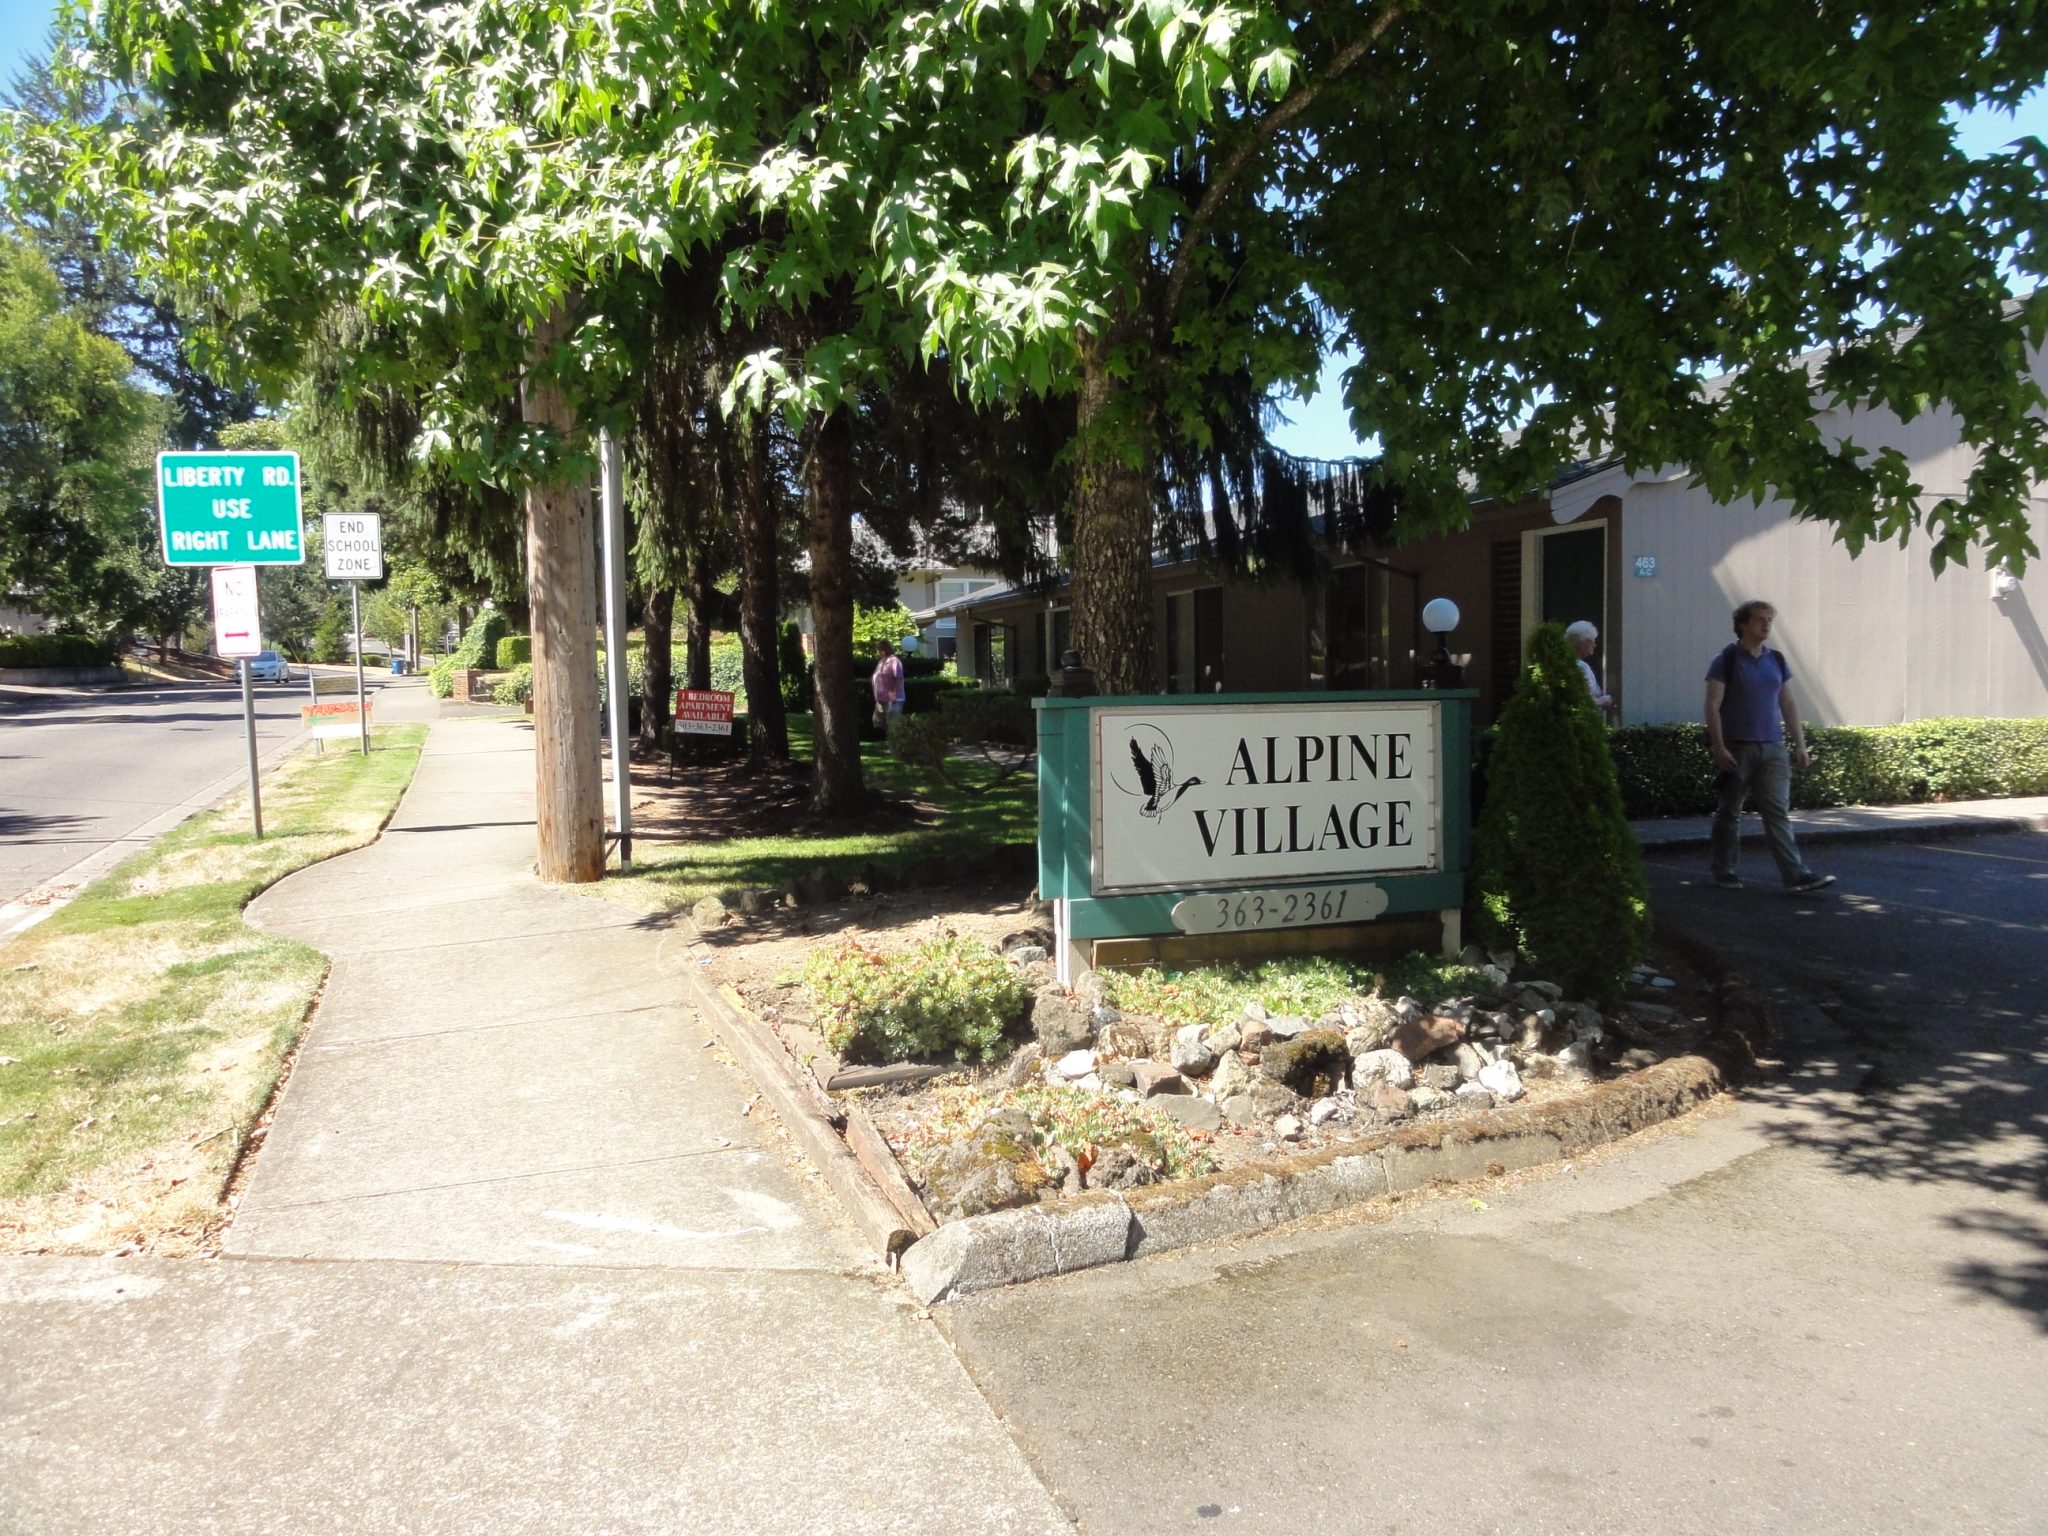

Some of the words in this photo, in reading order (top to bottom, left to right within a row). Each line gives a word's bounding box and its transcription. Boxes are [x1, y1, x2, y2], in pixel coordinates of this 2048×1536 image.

[164, 466, 246, 487] LIBERTY
[262, 466, 295, 487] RD.
[212, 498, 253, 519] USE
[340, 521, 364, 533] END
[171, 530, 230, 551] RIGHT
[247, 530, 298, 550] LANE
[328, 539, 378, 553] SCHOOL
[337, 558, 371, 571] ZONE
[1635, 556, 1655, 568] 463
[688, 692, 731, 702] BEDROOM
[679, 702, 732, 712] APARTMENT
[682, 711, 728, 721] AVAILABLE
[1225, 732, 1413, 786] ALPINE
[1193, 800, 1413, 858] VILLAGE
[1216, 888, 1348, 929] 363-2361
